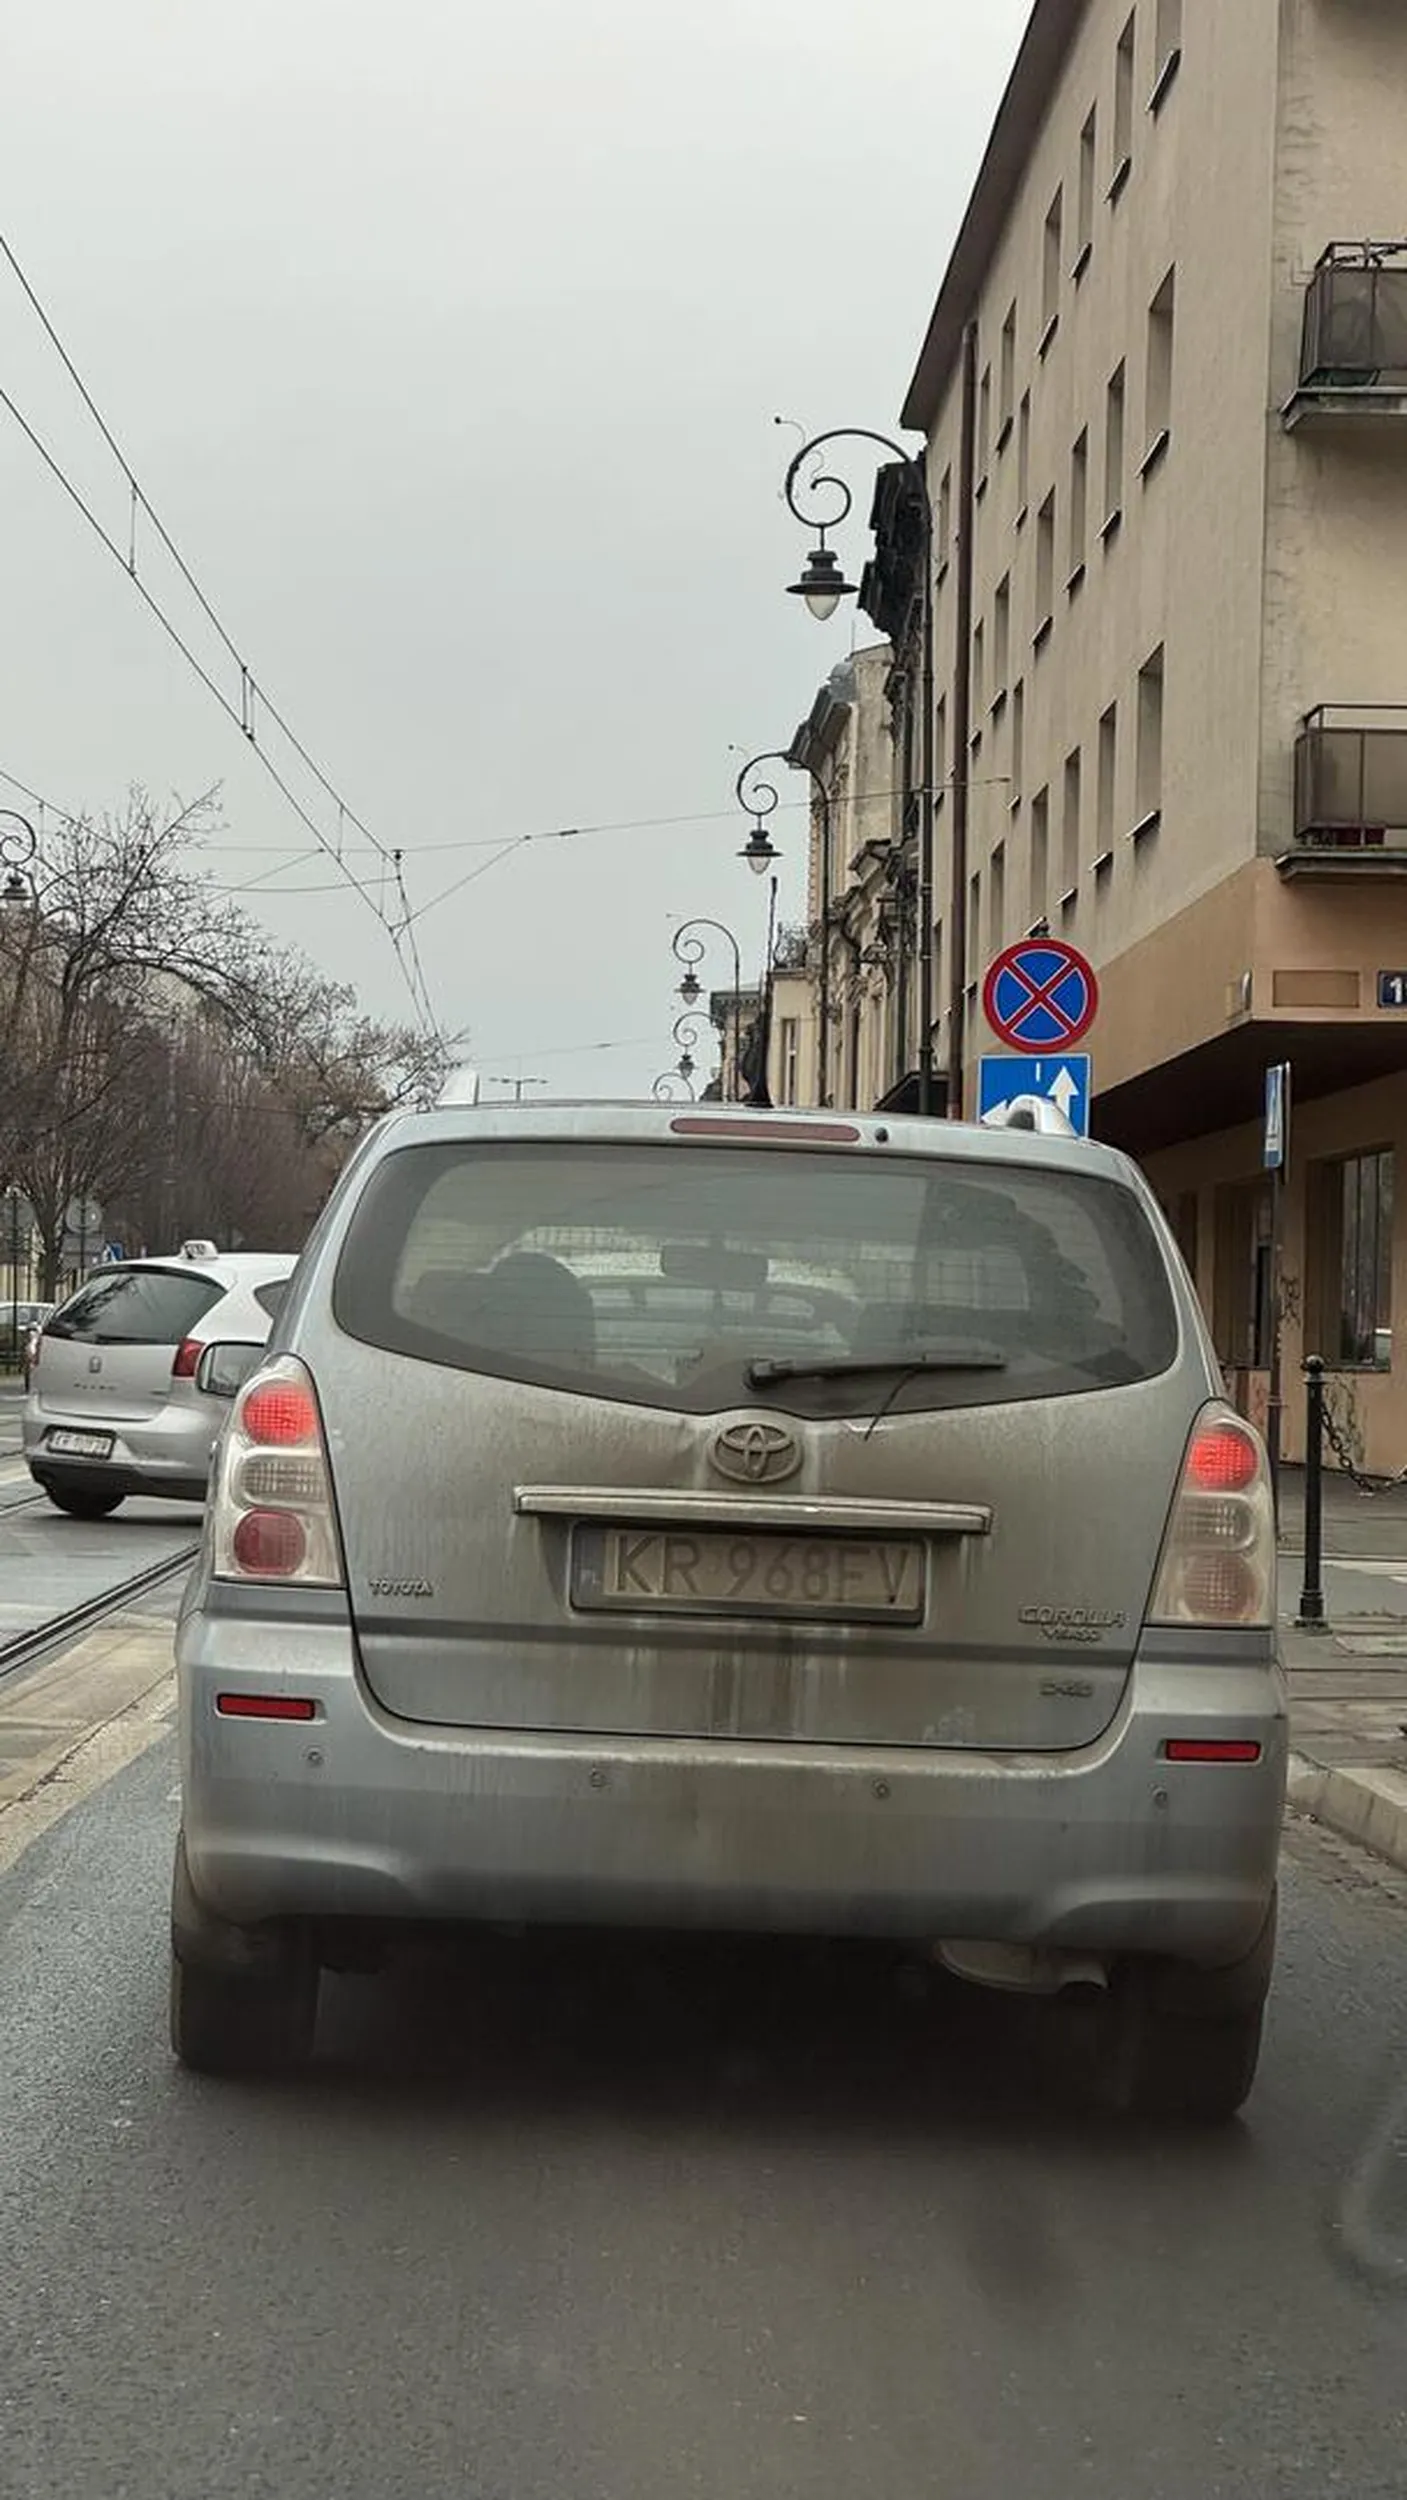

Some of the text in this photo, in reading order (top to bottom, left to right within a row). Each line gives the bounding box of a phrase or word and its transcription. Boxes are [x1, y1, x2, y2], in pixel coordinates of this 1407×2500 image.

[1389, 976, 1407, 1003] 1
[617, 1535, 909, 1605] KR 968FV
